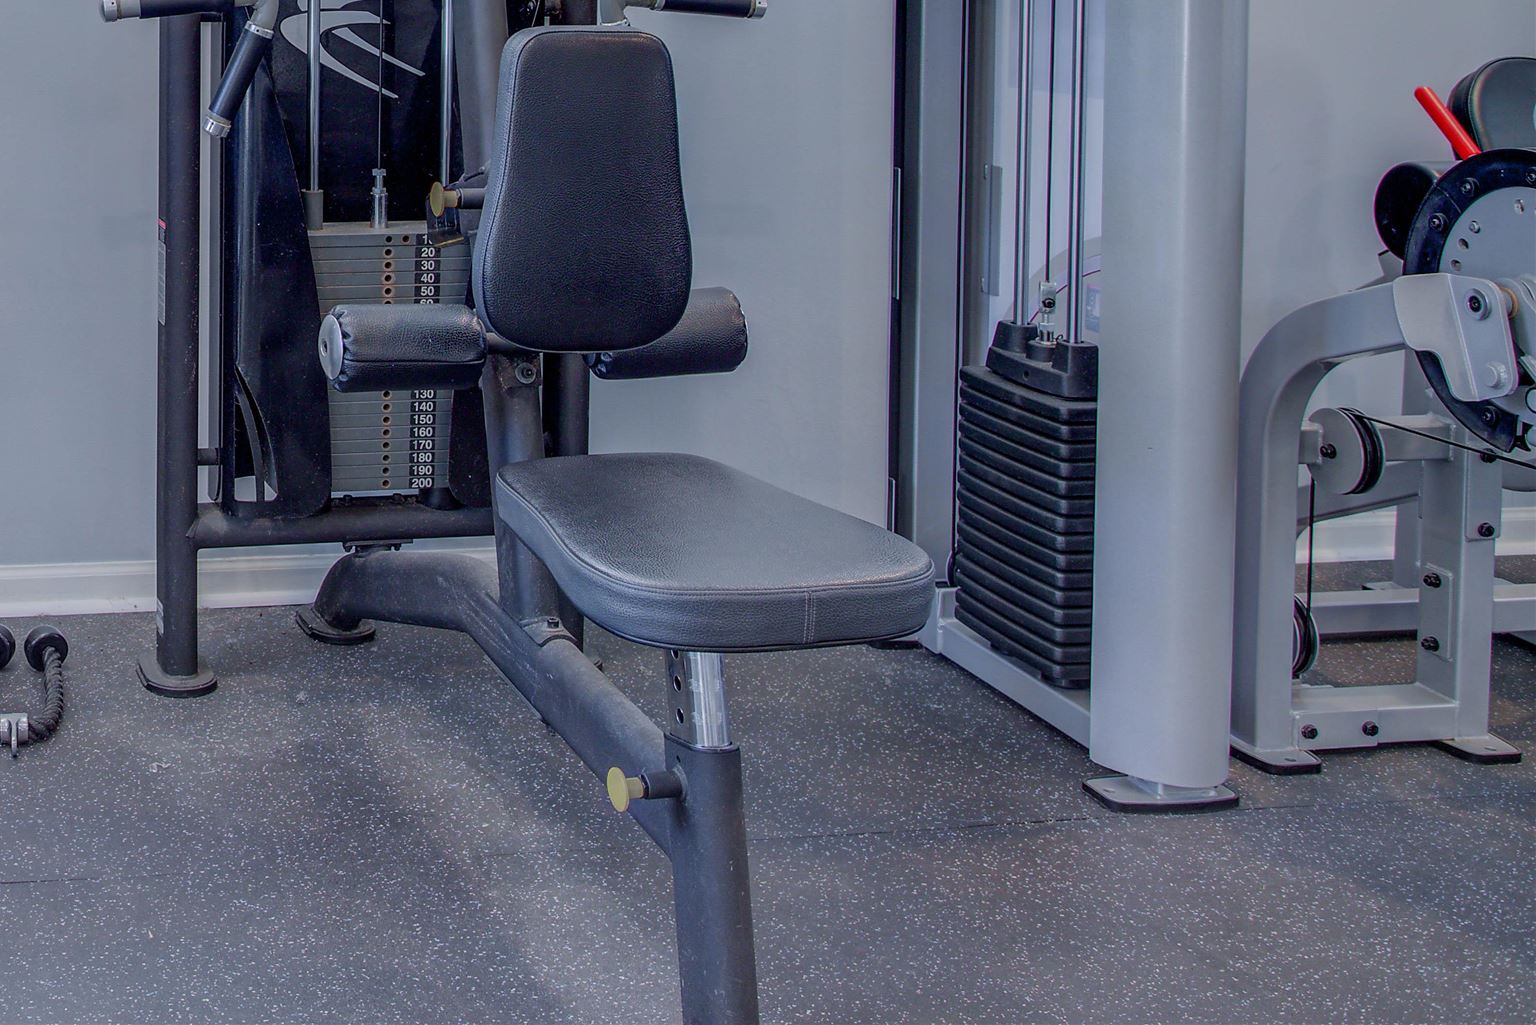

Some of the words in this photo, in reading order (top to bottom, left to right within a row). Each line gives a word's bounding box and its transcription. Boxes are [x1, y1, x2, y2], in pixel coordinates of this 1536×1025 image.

[421, 247, 435, 257] 20
[421, 260, 435, 270] 30
[420, 273, 435, 283] 40
[420, 286, 434, 296] 50
[413, 389, 434, 399] 130
[413, 401, 434, 412] 140
[413, 414, 433, 424] 150
[412, 427, 433, 437] 160
[412, 440, 433, 450] 170
[411, 452, 432, 463] 180
[411, 465, 432, 476] 190
[411, 478, 432, 488] 200
